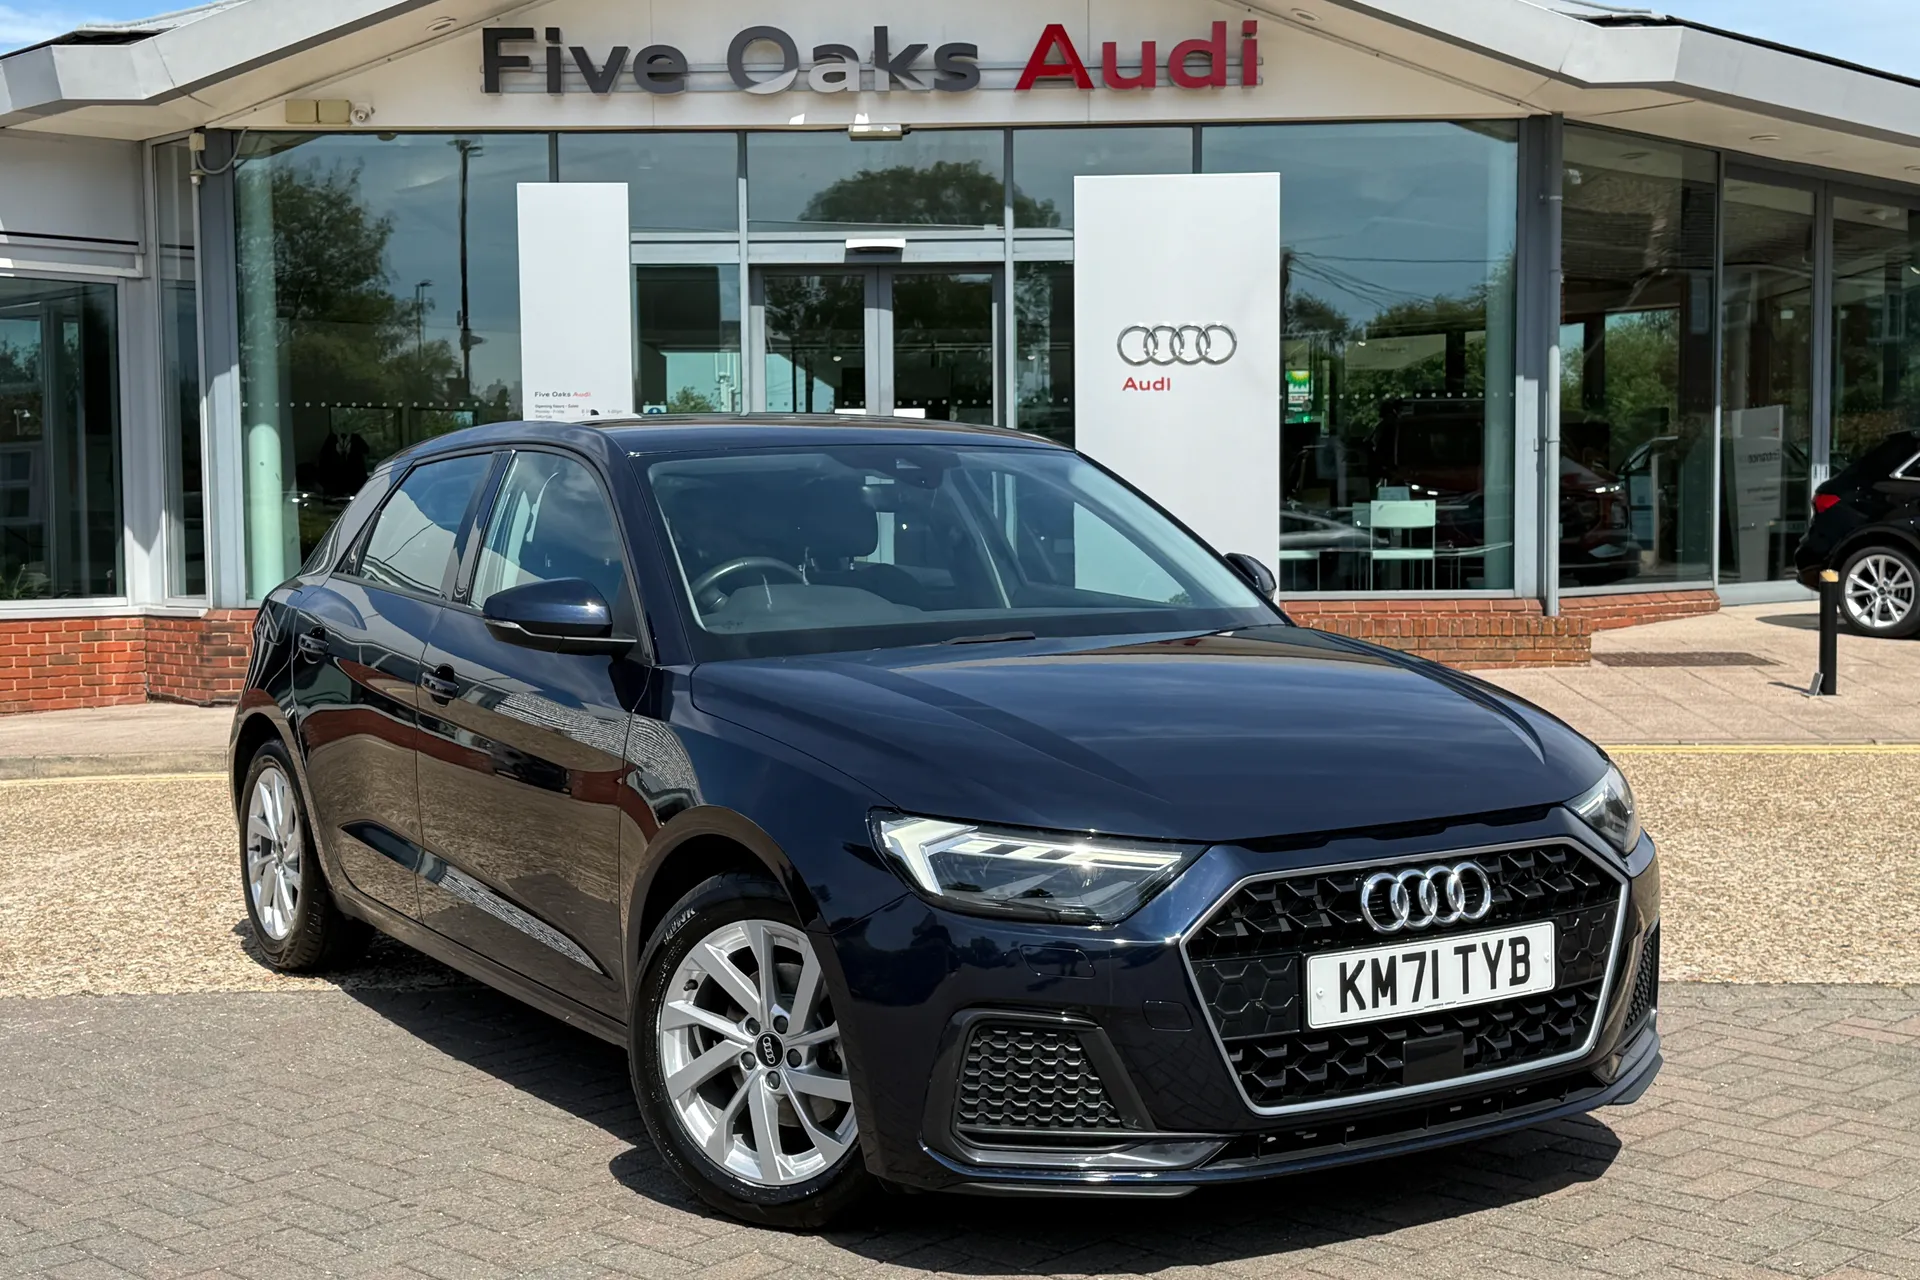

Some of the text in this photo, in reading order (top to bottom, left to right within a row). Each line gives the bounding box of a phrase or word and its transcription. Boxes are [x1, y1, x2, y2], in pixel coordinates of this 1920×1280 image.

[482, 20, 1258, 95] Five Oaks Audi
[1122, 376, 1171, 391] Audi
[1339, 935, 1531, 1013] KM71 TYB
